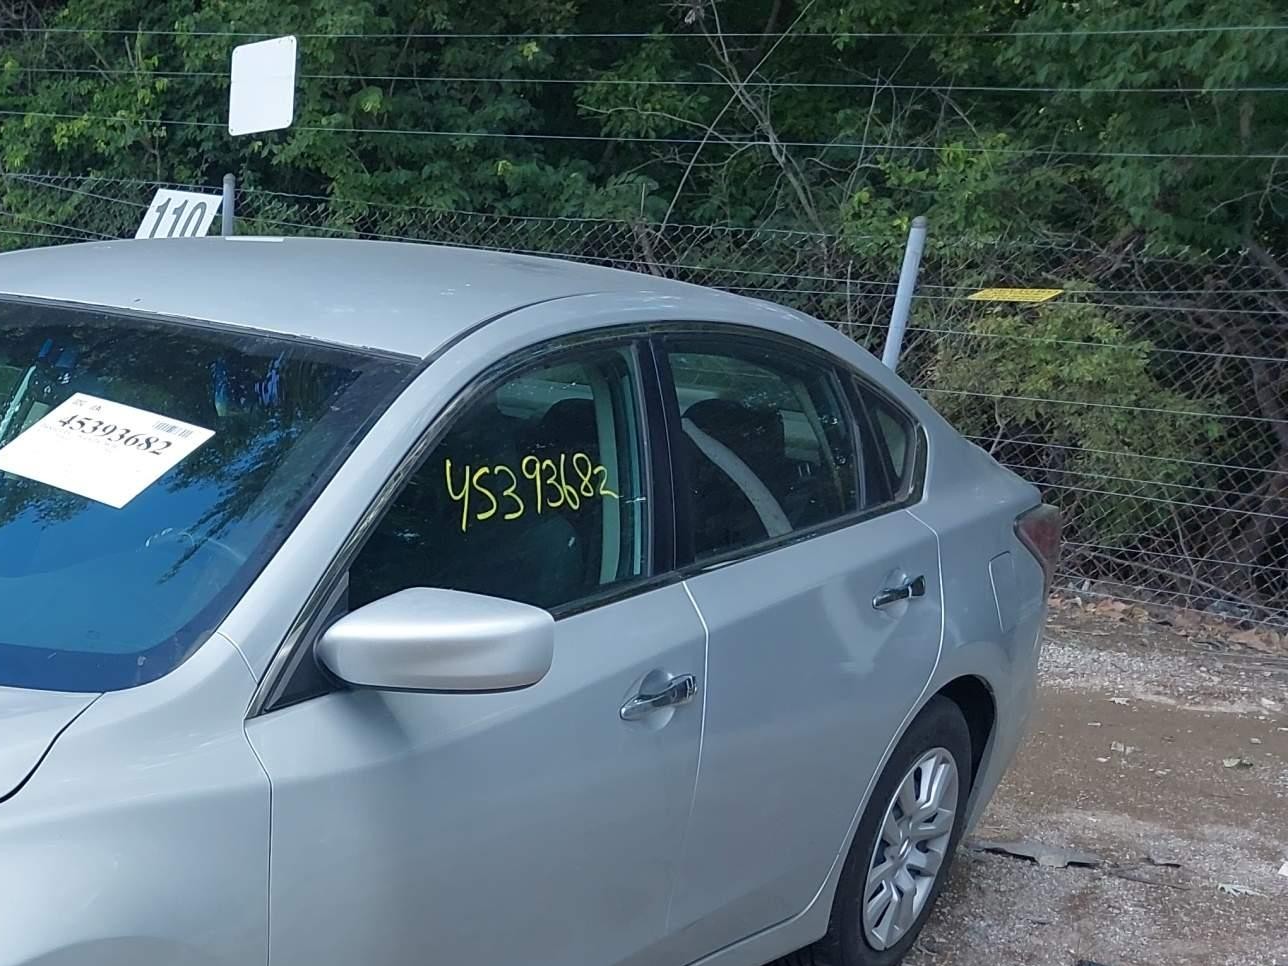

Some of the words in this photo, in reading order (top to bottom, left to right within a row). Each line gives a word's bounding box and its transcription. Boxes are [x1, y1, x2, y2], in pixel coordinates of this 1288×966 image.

[148, 197, 208, 239] 110
[58, 413, 173, 456] 45393682
[445, 452, 619, 532] 45393682
